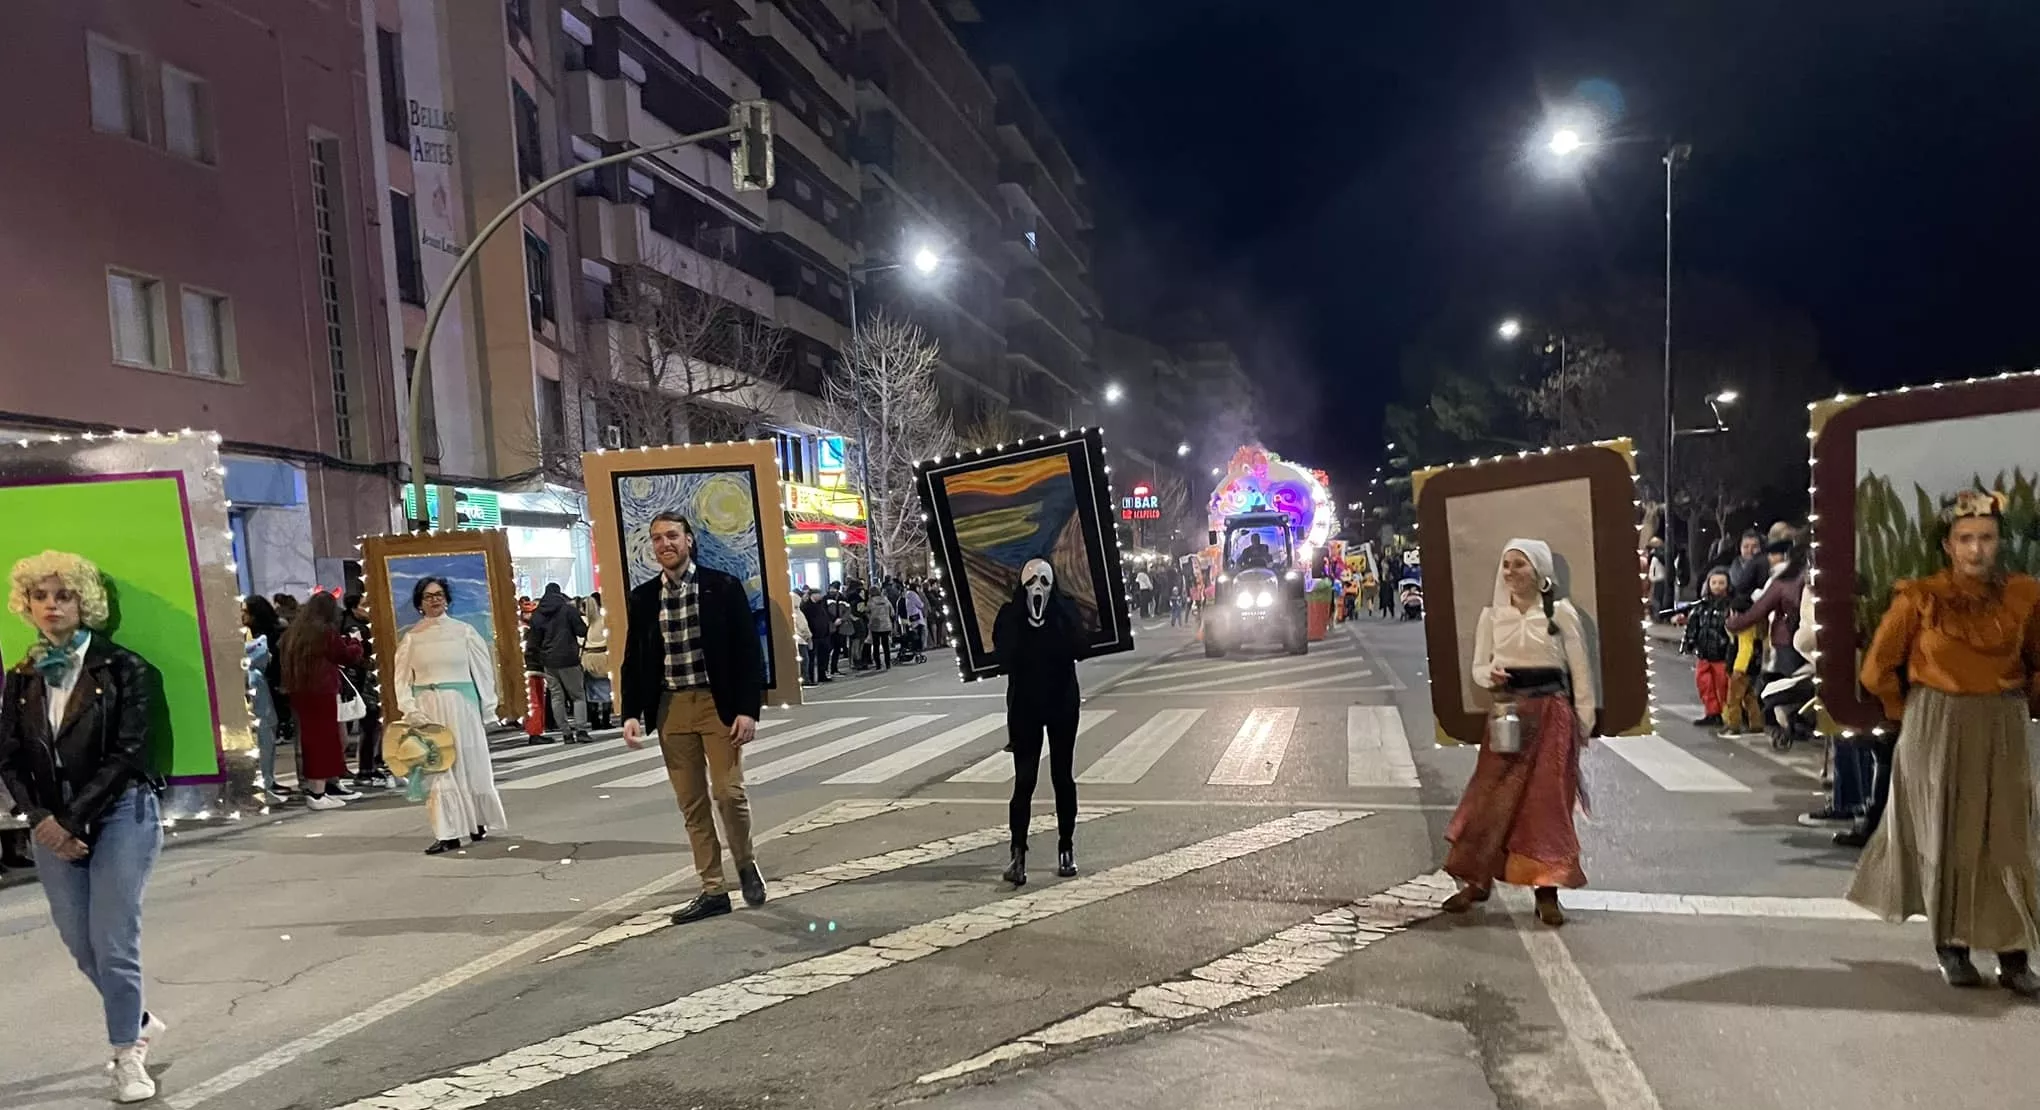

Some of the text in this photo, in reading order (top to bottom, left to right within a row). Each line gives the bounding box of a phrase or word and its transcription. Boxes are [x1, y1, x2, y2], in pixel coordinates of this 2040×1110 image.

[409, 99, 457, 132] BELLAS
[414, 135, 454, 166] ARTES
[1134, 496, 1158, 508] BAR
